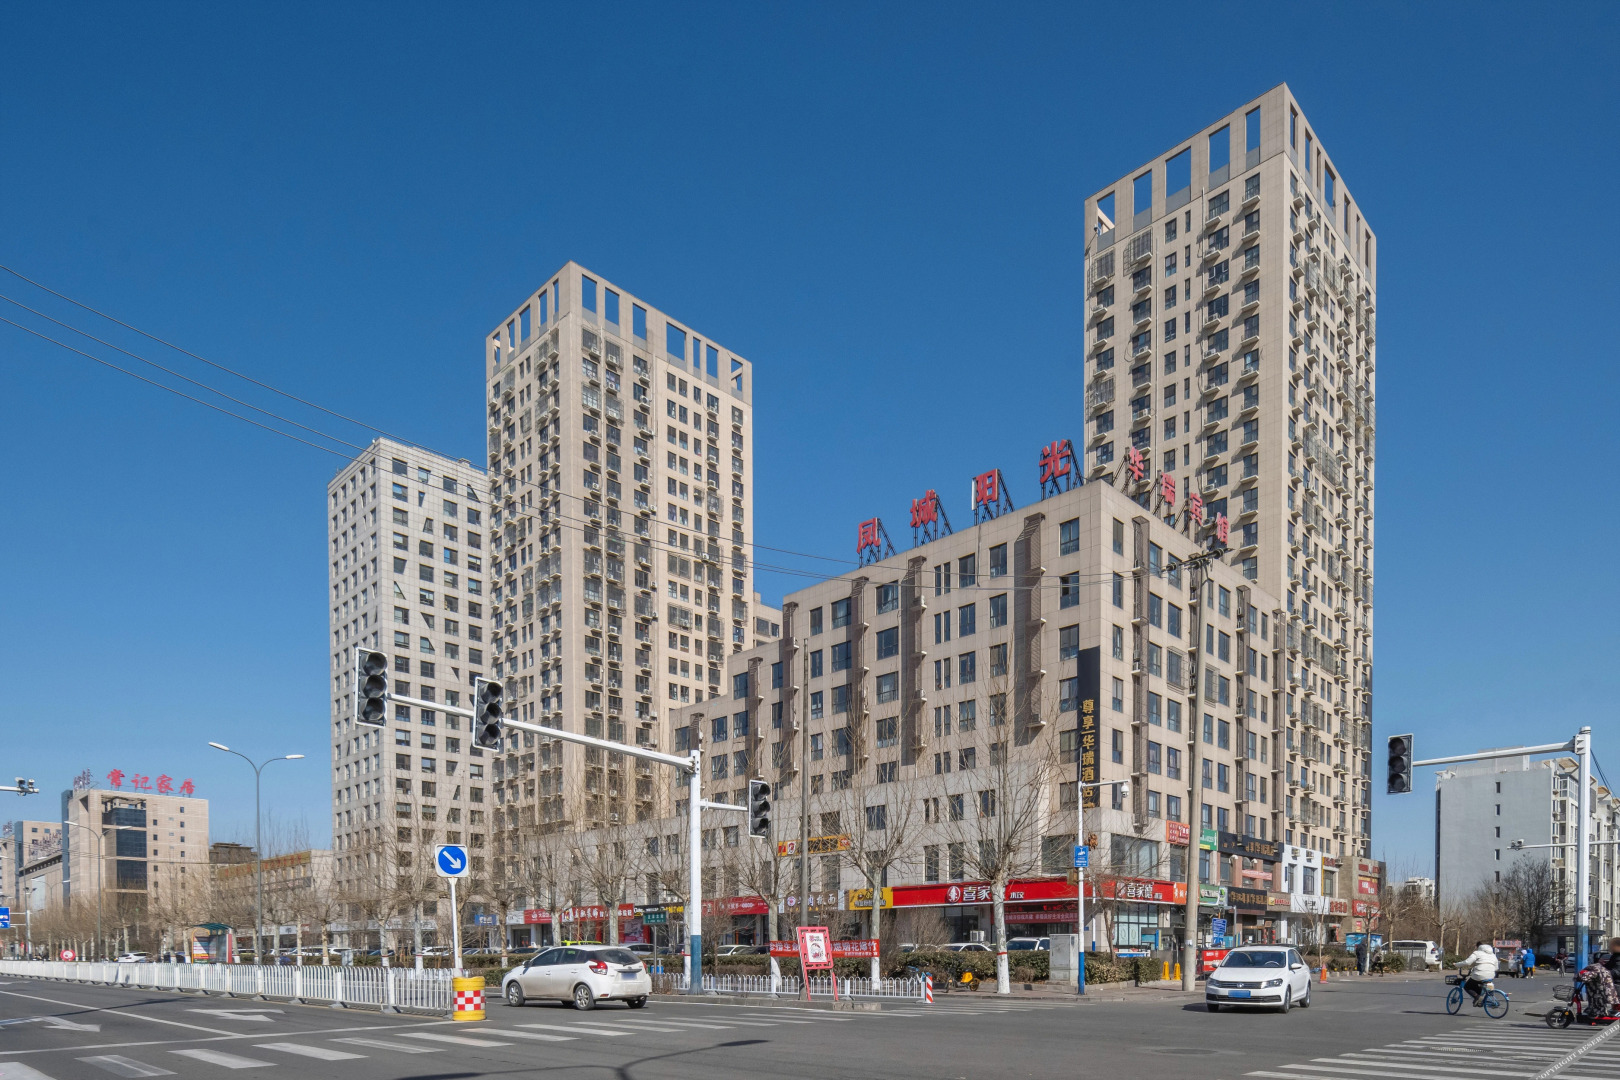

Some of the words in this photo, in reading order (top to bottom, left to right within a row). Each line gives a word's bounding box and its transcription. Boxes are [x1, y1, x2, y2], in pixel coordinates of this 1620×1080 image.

[856, 439, 1071, 555] 凤城阳光
[1128, 446, 1230, 545] 华瑞宾馆
[830, 941, 877, 952] 燃烟花爆竹
